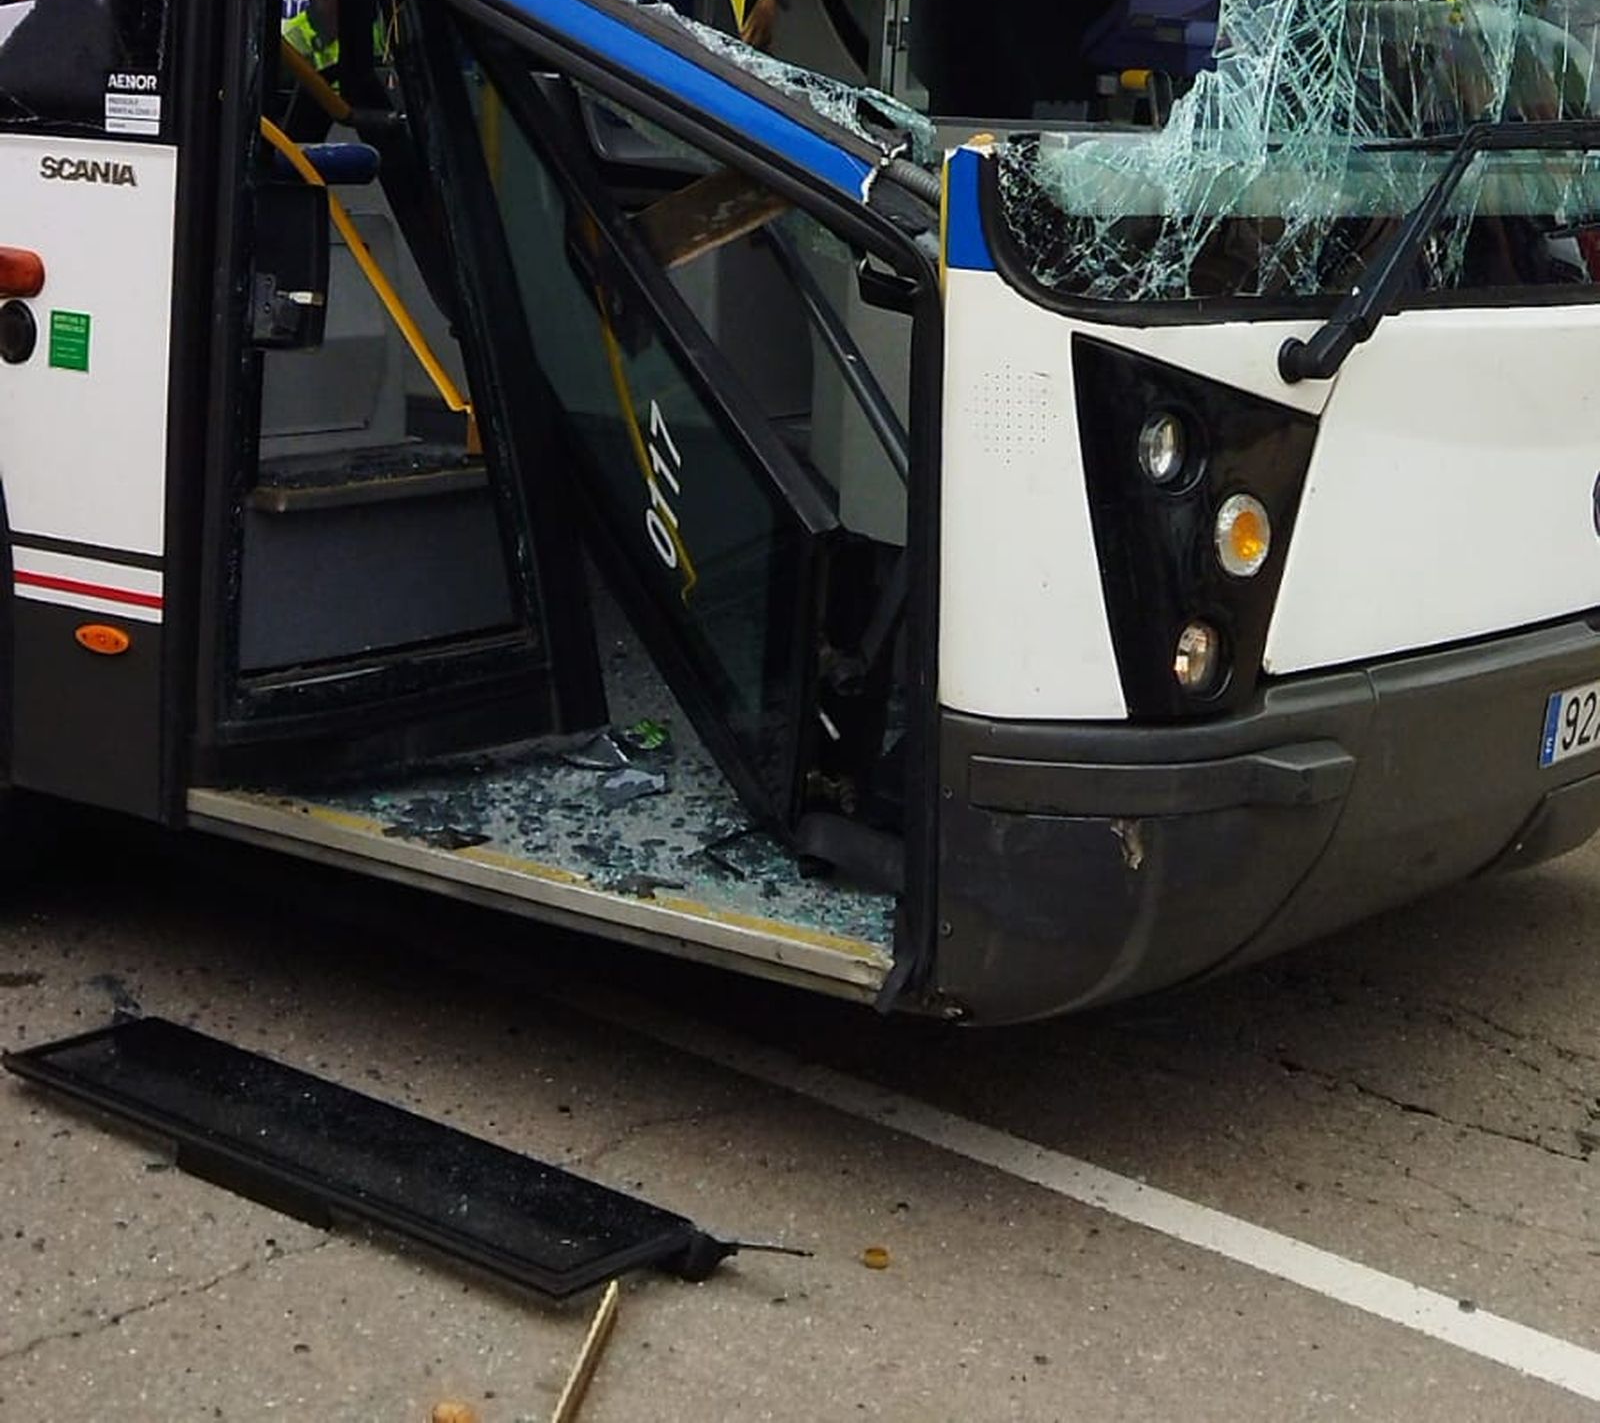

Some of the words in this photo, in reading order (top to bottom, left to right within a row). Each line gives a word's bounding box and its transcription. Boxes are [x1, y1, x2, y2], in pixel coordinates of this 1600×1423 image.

[107, 73, 158, 91] AENOR
[40, 155, 137, 187] SCANIA
[645, 399, 682, 569] 0117
[1561, 691, 1600, 752] 92
